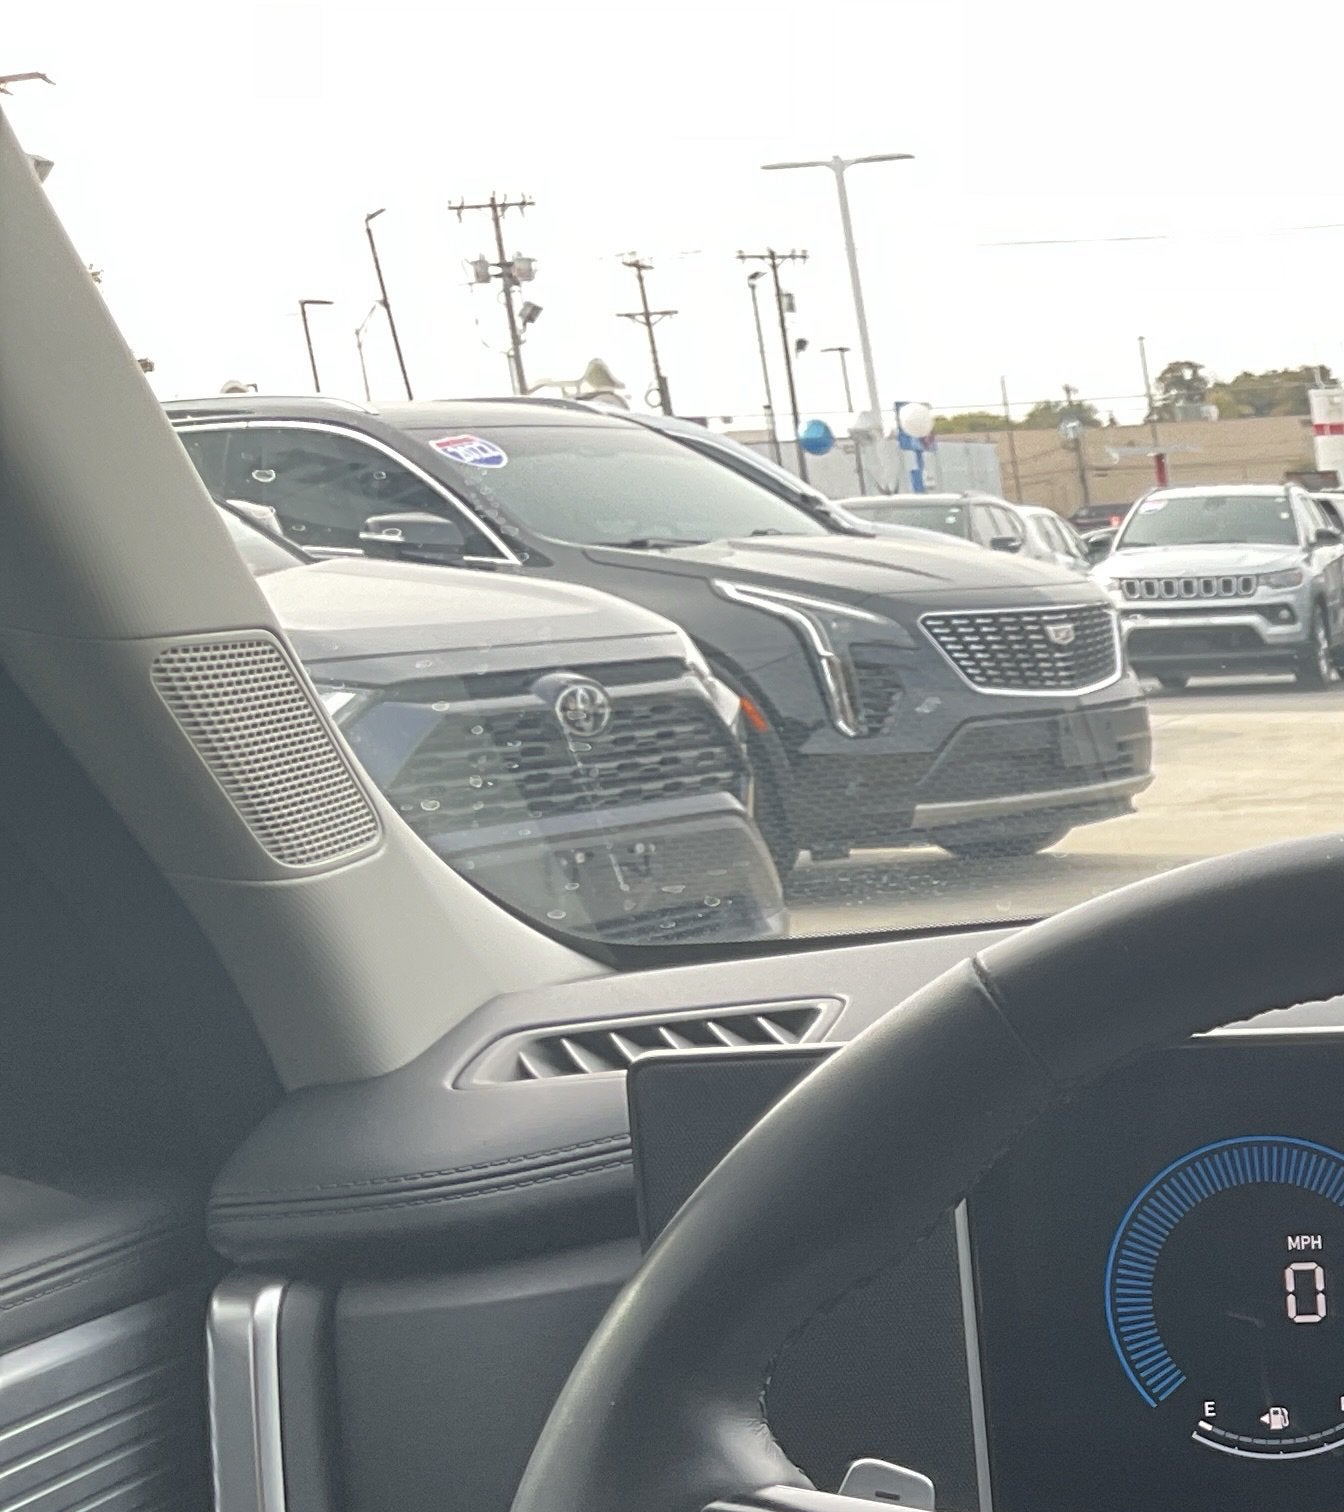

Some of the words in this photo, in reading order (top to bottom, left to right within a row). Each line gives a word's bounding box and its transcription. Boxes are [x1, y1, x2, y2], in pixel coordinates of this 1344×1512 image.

[1287, 1235, 1323, 1251] MPH
[1284, 1261, 1328, 1324] 0
[1203, 1401, 1216, 1418] E
